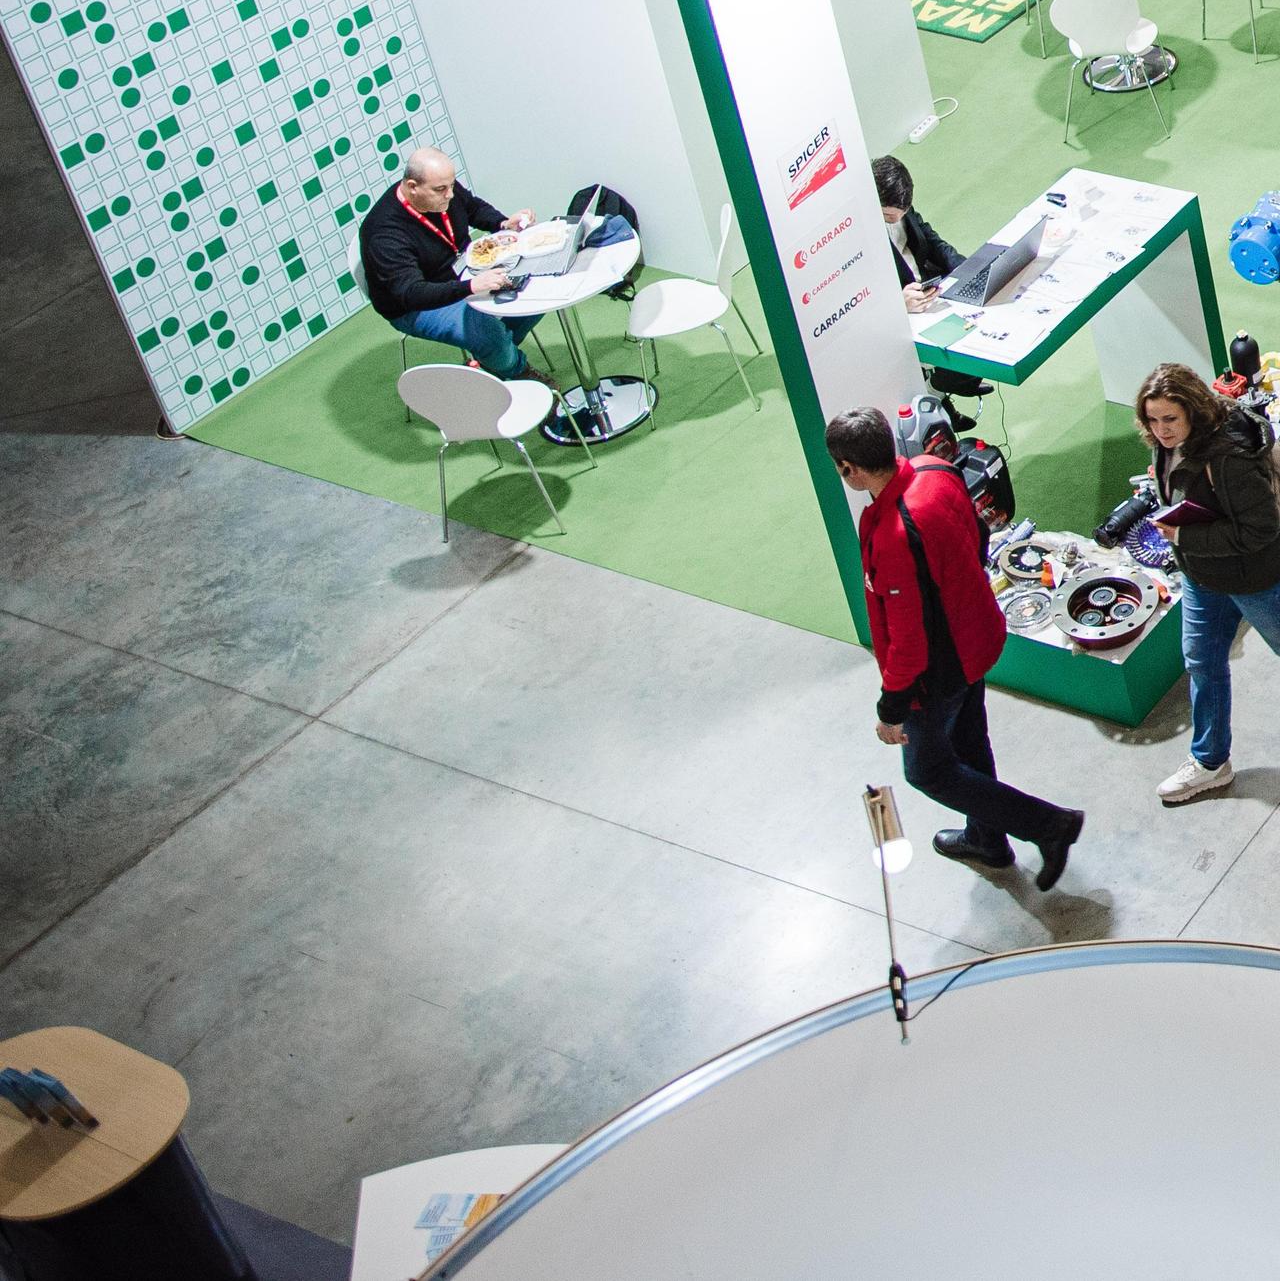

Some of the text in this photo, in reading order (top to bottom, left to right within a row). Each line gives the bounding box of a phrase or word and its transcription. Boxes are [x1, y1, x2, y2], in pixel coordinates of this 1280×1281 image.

[788, 126, 830, 179] SPICER
[809, 217, 853, 256] CARRARO
[811, 251, 864, 296] CARRARO SERVICE
